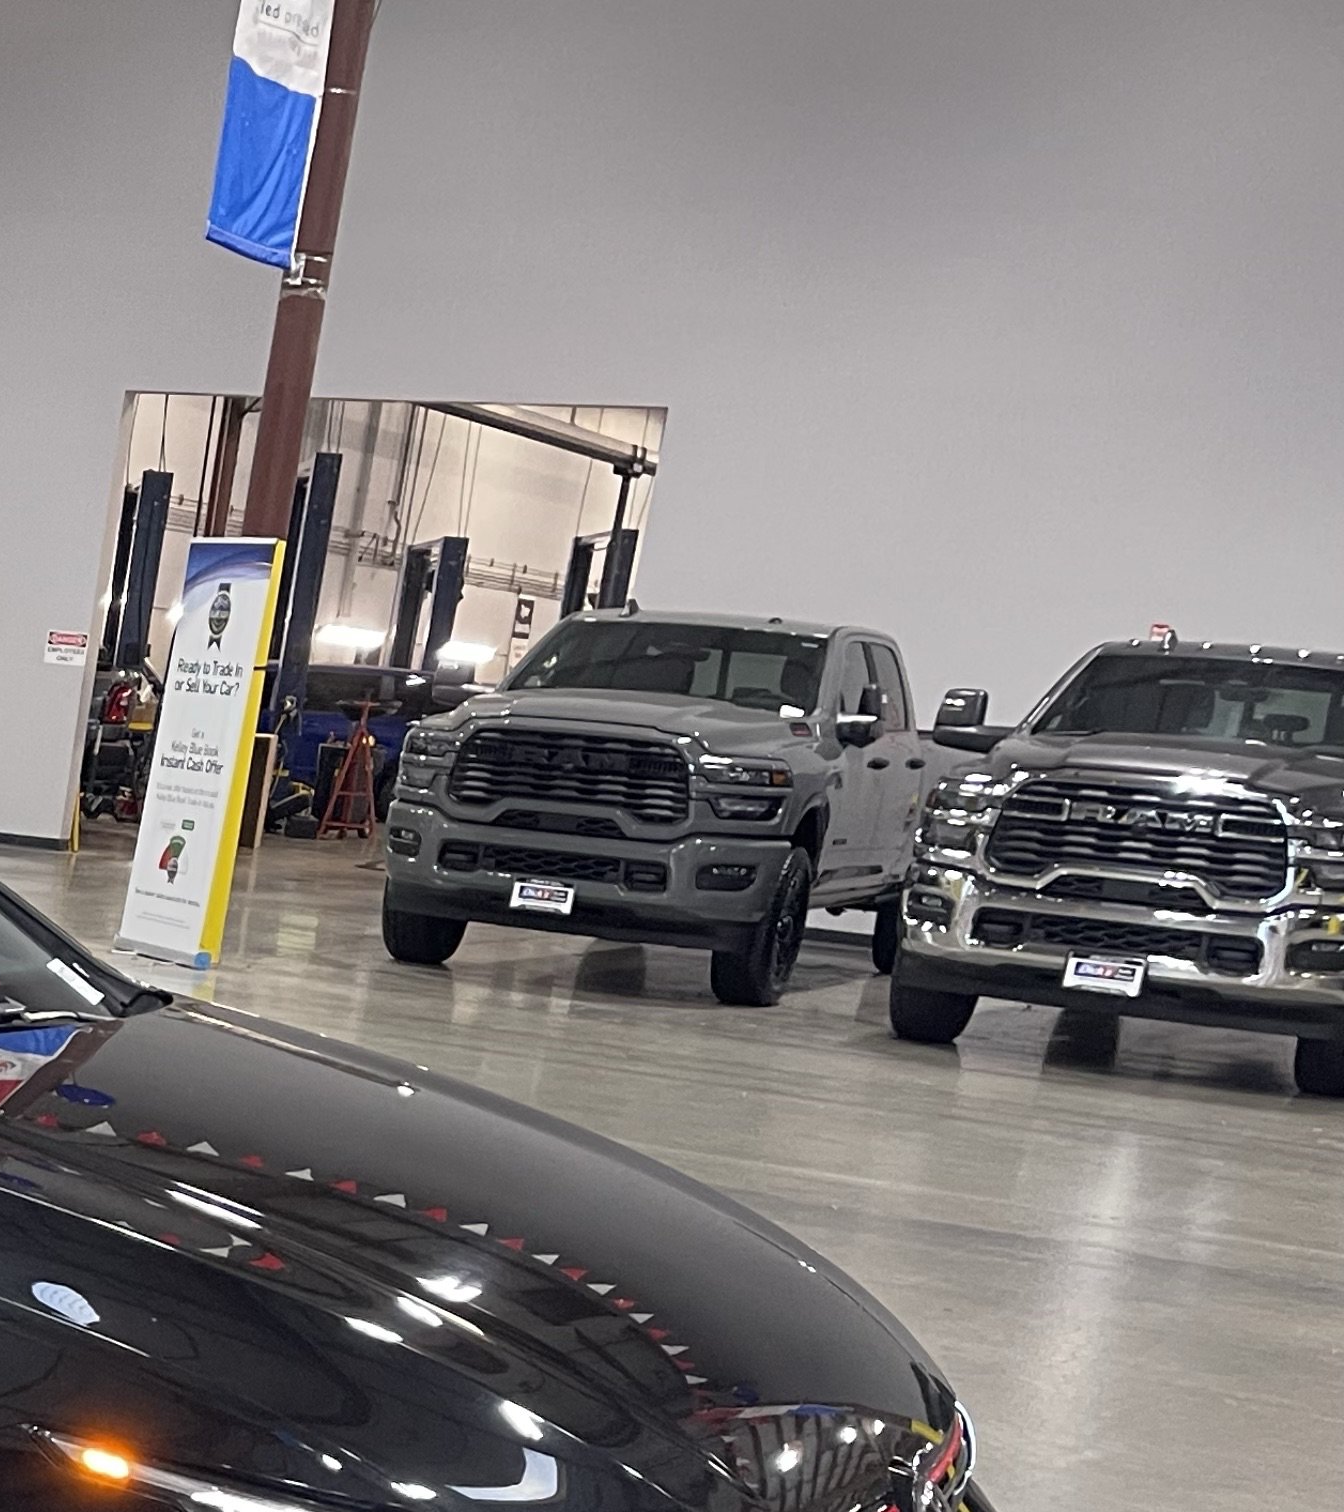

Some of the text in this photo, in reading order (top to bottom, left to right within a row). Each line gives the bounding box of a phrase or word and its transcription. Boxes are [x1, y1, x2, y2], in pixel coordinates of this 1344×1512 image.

[177, 658, 244, 679] Ready to Trade In
[175, 677, 240, 697] or Sell Your Car?
[186, 757, 204, 772] Cash
[205, 759, 224, 775] Offer
[1070, 801, 1214, 832] RAM
